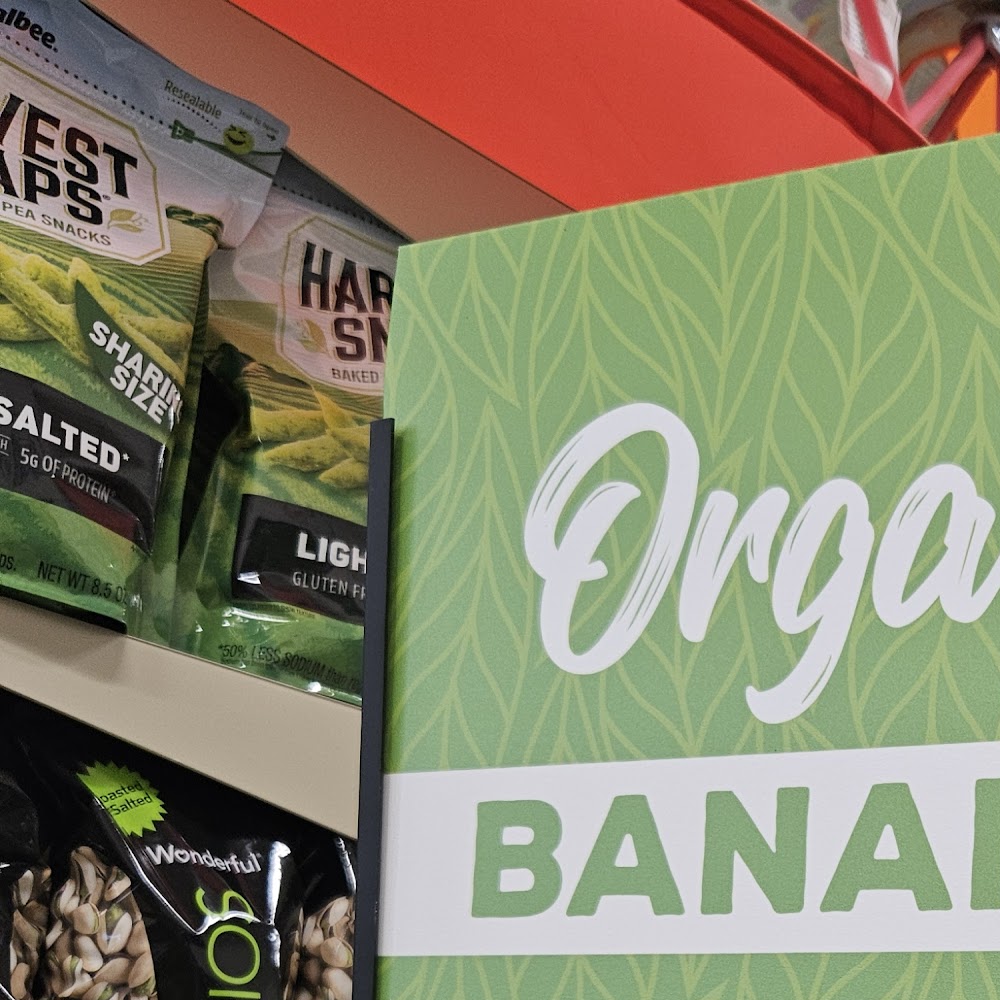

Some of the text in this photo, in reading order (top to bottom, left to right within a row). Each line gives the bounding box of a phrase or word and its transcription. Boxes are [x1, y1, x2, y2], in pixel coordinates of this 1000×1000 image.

[164, 79, 222, 119] Resealable
[2, 202, 112, 246] PEA SNACKS
[330, 368, 380, 384] BAKED
[109, 364, 169, 425] SIZE
[42, 455, 62, 476] OF
[37, 560, 66, 584] NET
[67, 569, 90, 591] WT
[292, 571, 348, 596] GLUTEN
[145, 843, 262, 875] Wonderful
